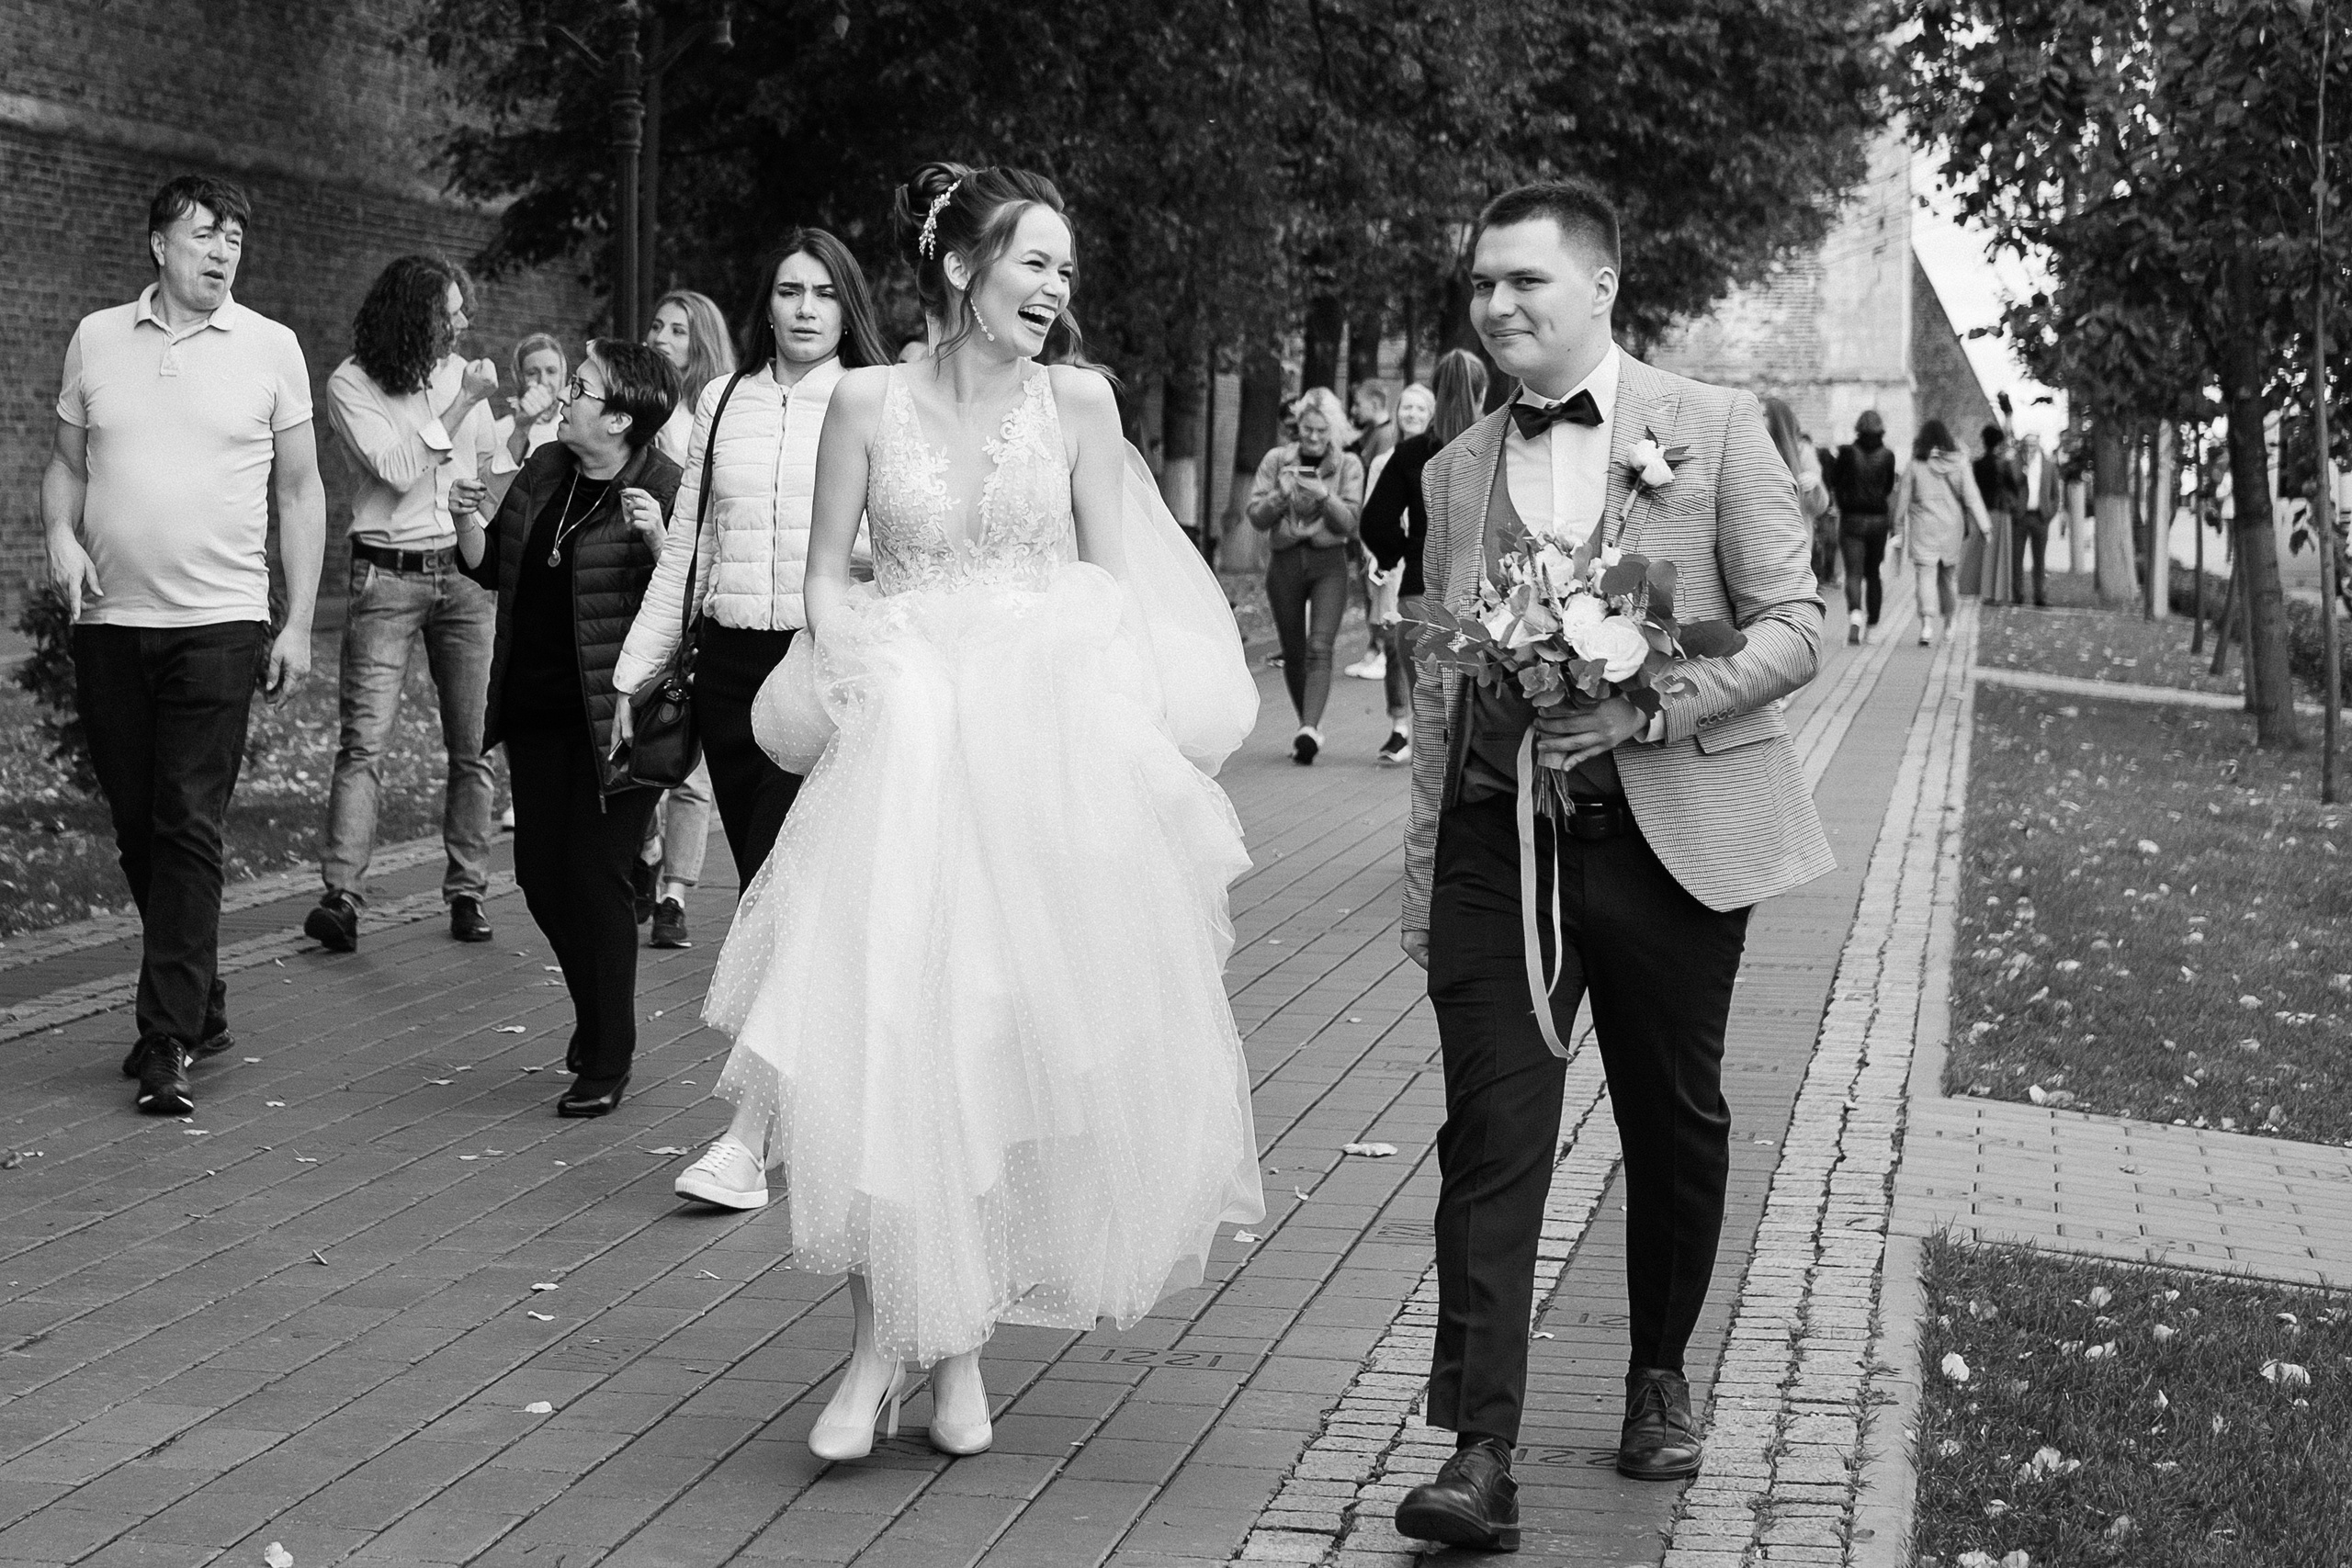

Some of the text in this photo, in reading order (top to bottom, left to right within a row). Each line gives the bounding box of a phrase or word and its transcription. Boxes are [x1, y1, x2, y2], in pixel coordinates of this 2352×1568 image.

[1579, 1313, 1630, 1325] 12
[1100, 1349, 1222, 1368] 1221
[1514, 1448, 1620, 1466] 122
